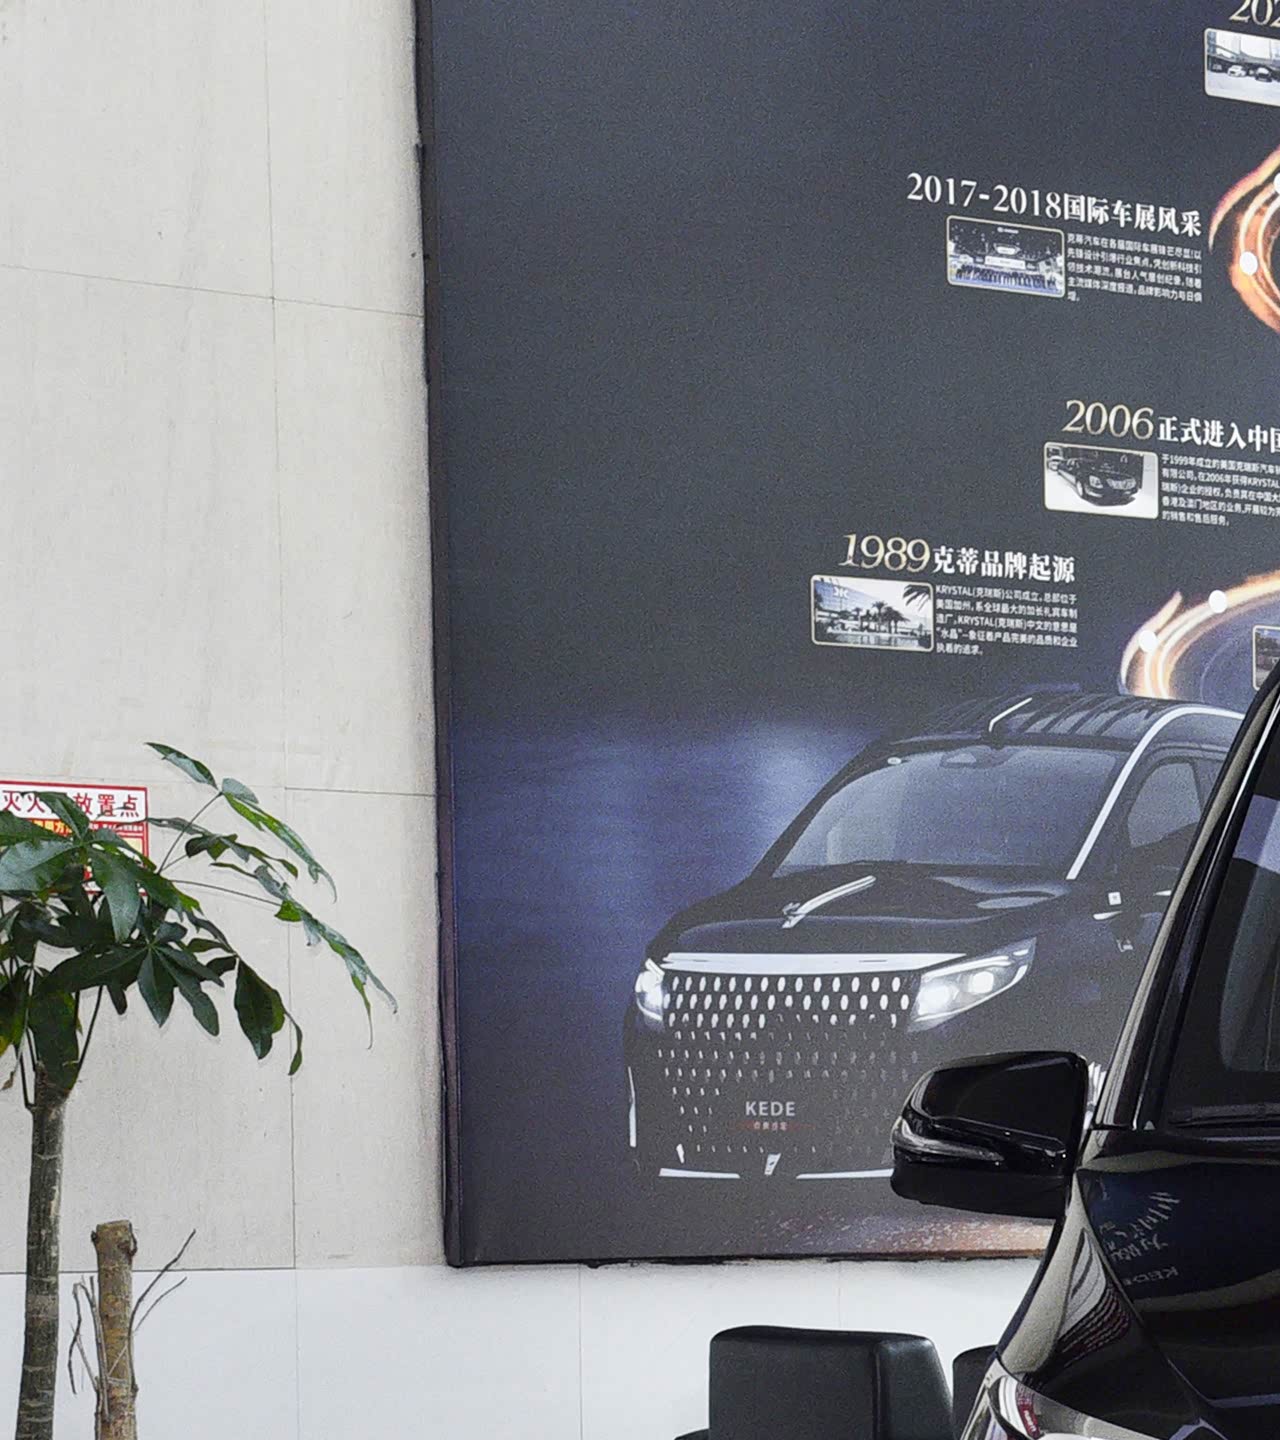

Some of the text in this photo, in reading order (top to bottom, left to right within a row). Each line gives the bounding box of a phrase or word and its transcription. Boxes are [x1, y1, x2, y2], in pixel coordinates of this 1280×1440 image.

[906, 172, 1202, 238] 2017-2018国际车展风采
[838, 532, 1076, 584] 1989克蒂品牌起源
[3, 790, 140, 818] 灭火放置点
[745, 1100, 796, 1117] KEDE
